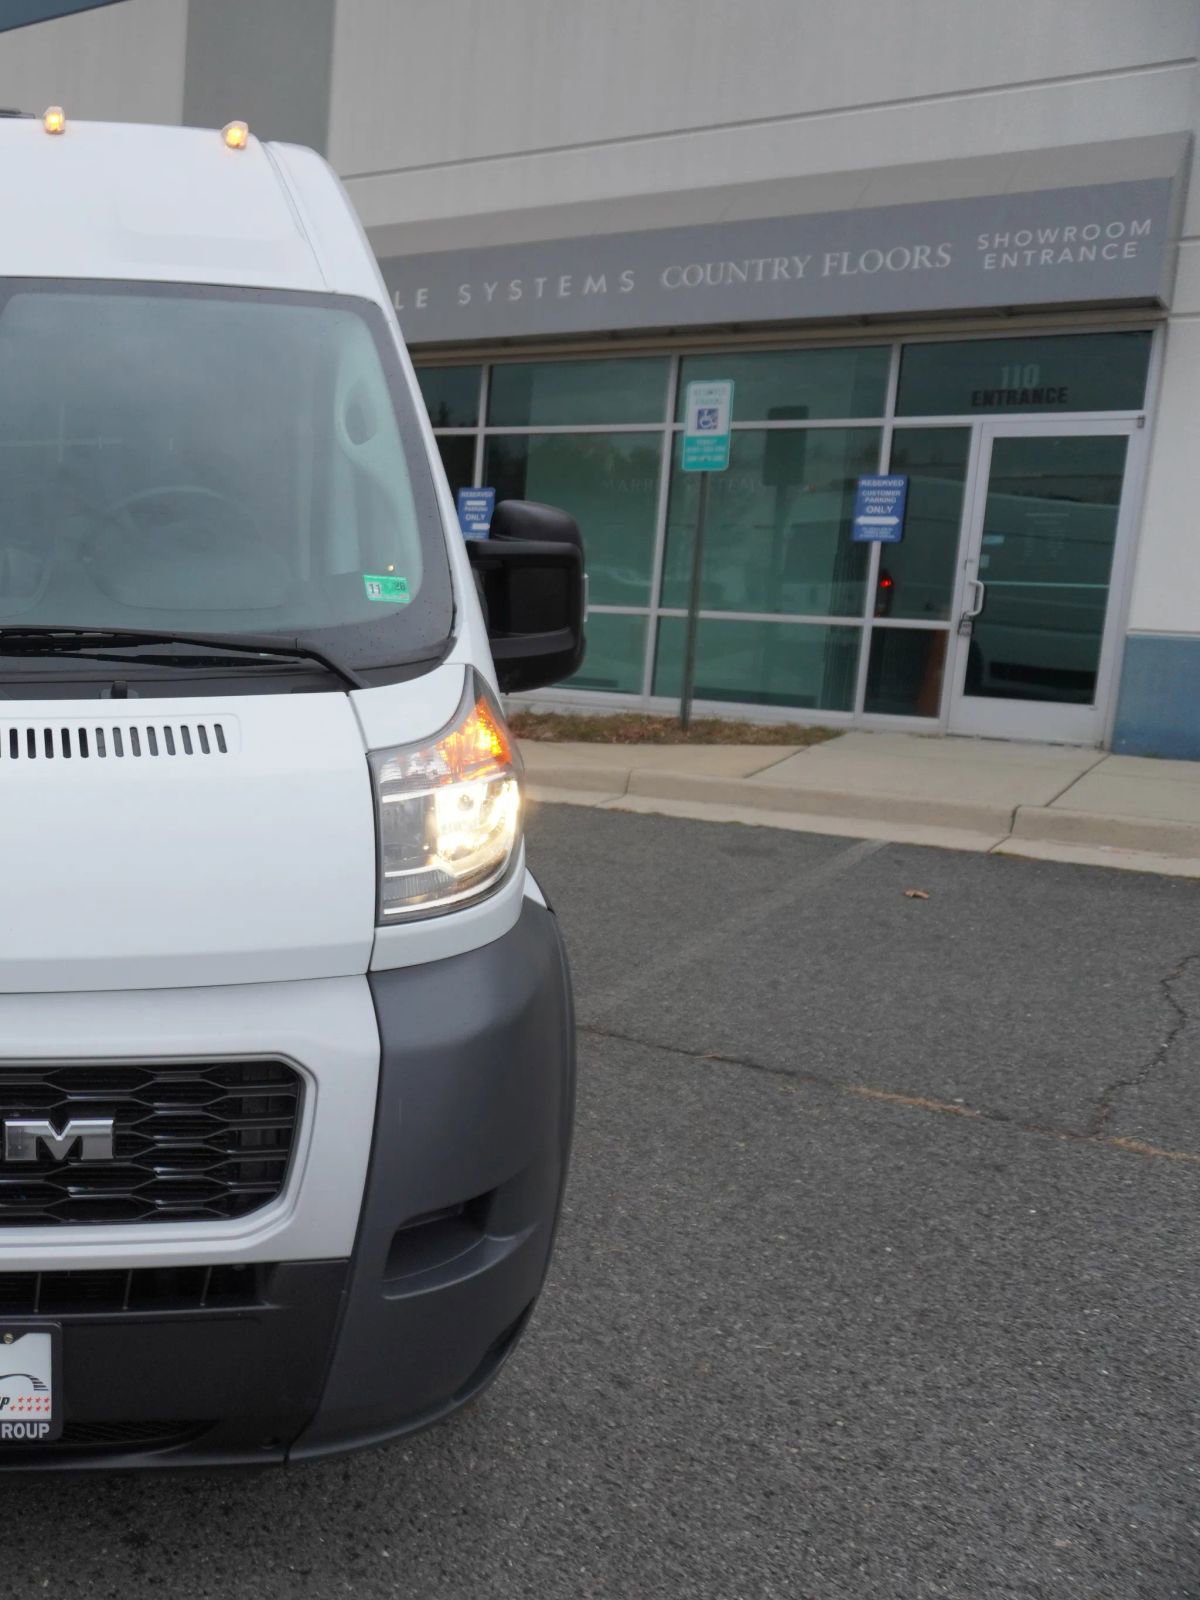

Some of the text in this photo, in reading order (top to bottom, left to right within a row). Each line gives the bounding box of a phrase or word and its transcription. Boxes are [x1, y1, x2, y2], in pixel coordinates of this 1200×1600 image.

[977, 219, 1152, 250] SHOWROOM
[661, 243, 952, 289] COUNTRY FLOORS
[984, 241, 1138, 270] ENTRANCE
[394, 269, 636, 310] LE SYSTEMS
[1002, 363, 1040, 389] 110
[971, 387, 1069, 407] ENTRANCE
[862, 489, 901, 497] CUSTOMER
[465, 513, 486, 521] ONLY
[865, 505, 894, 514] ONLY
